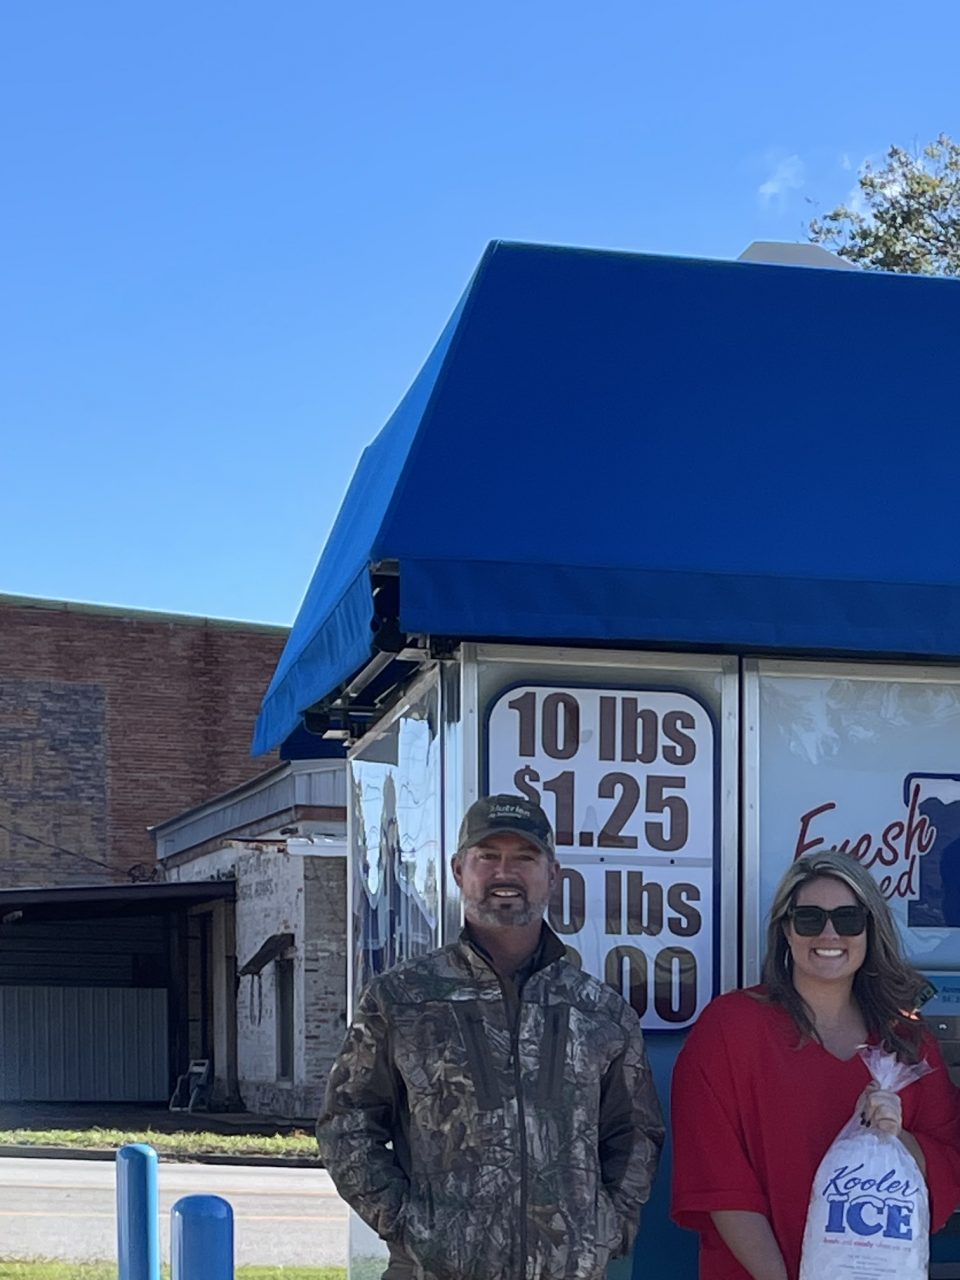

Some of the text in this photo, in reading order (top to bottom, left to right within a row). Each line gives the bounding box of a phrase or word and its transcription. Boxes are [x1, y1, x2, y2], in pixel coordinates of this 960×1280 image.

[508, 691, 697, 766] 10 lbs
[513, 764, 689, 852] $1.25
[547, 868, 702, 937] 0 lbs
[822, 1163, 920, 1198] Kooler
[825, 1193, 915, 1241] ICE
